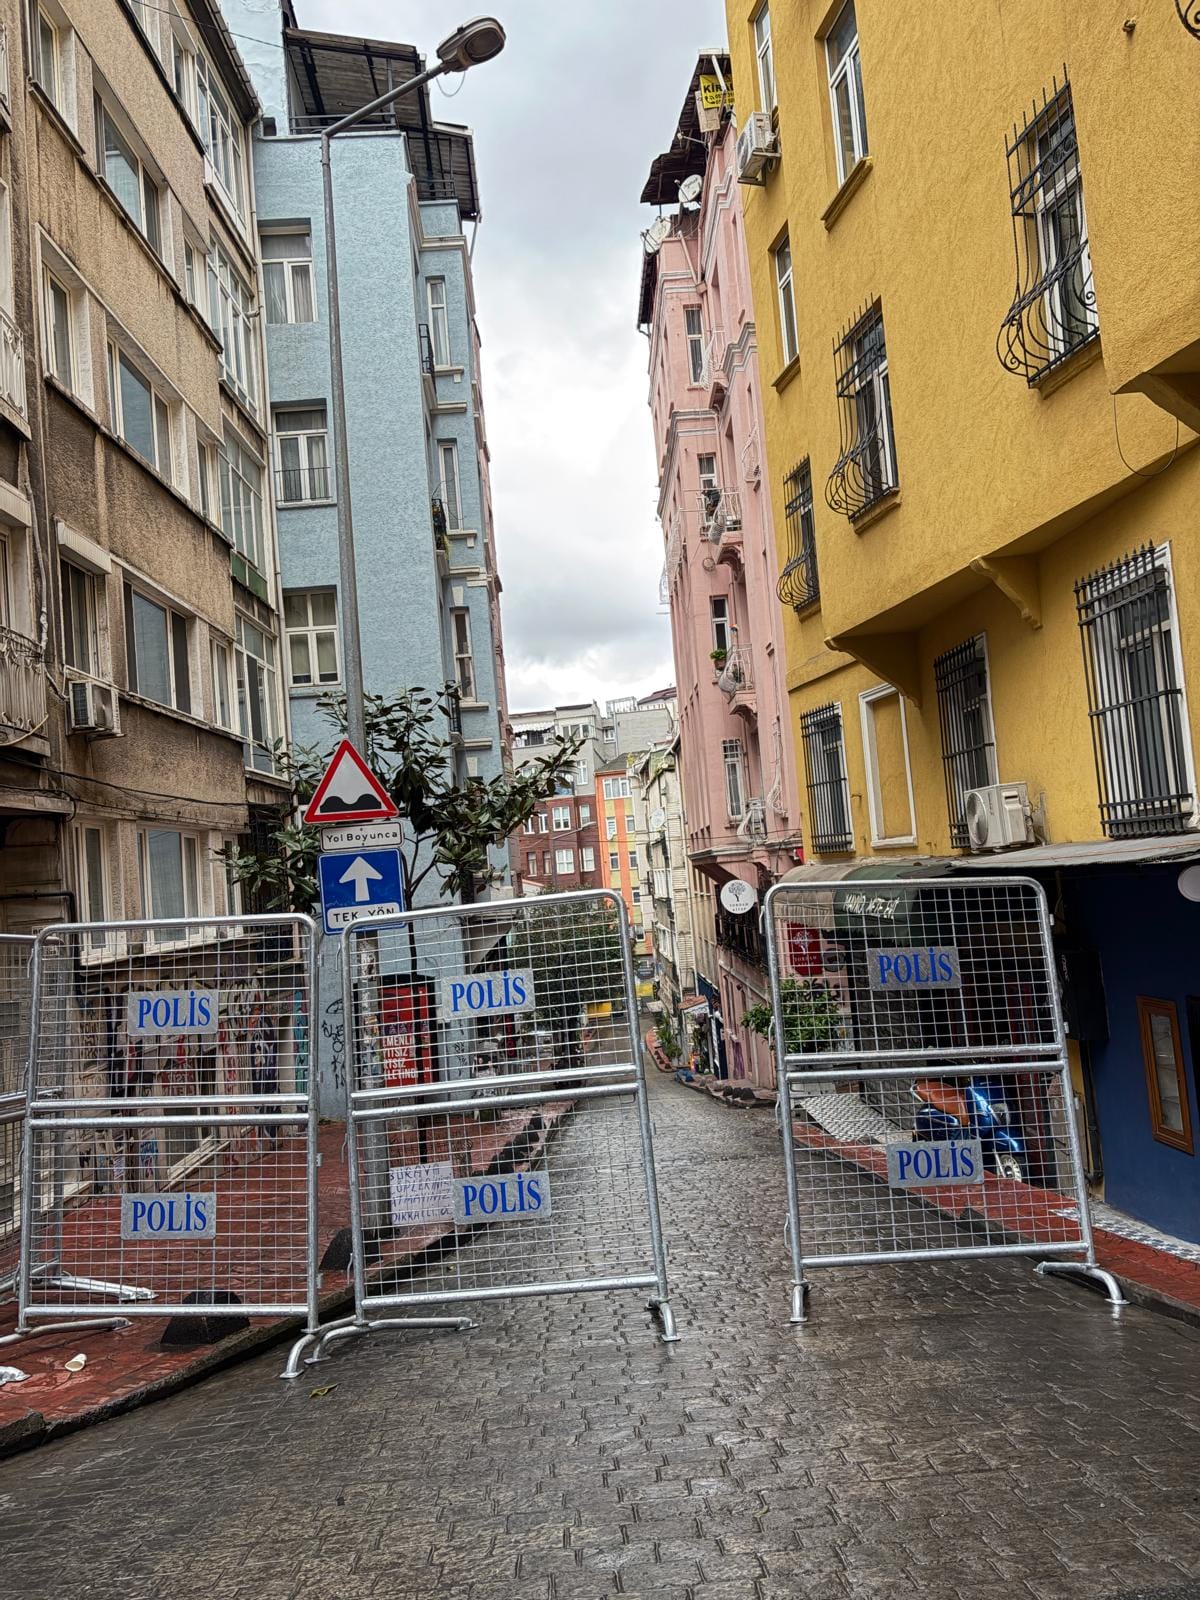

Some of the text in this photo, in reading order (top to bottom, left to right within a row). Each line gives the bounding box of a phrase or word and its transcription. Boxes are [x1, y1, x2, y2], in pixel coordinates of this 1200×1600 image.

[326, 831, 398, 843] Yol Boyunca
[333, 906, 395, 923] TEK YÖN
[879, 948, 952, 984] POLİS
[139, 991, 210, 1028] POLİS
[451, 970, 525, 1012] POLİS
[896, 1141, 974, 1181] POLİS
[133, 1194, 206, 1232] POLİS
[463, 1174, 541, 1217] POLİS
